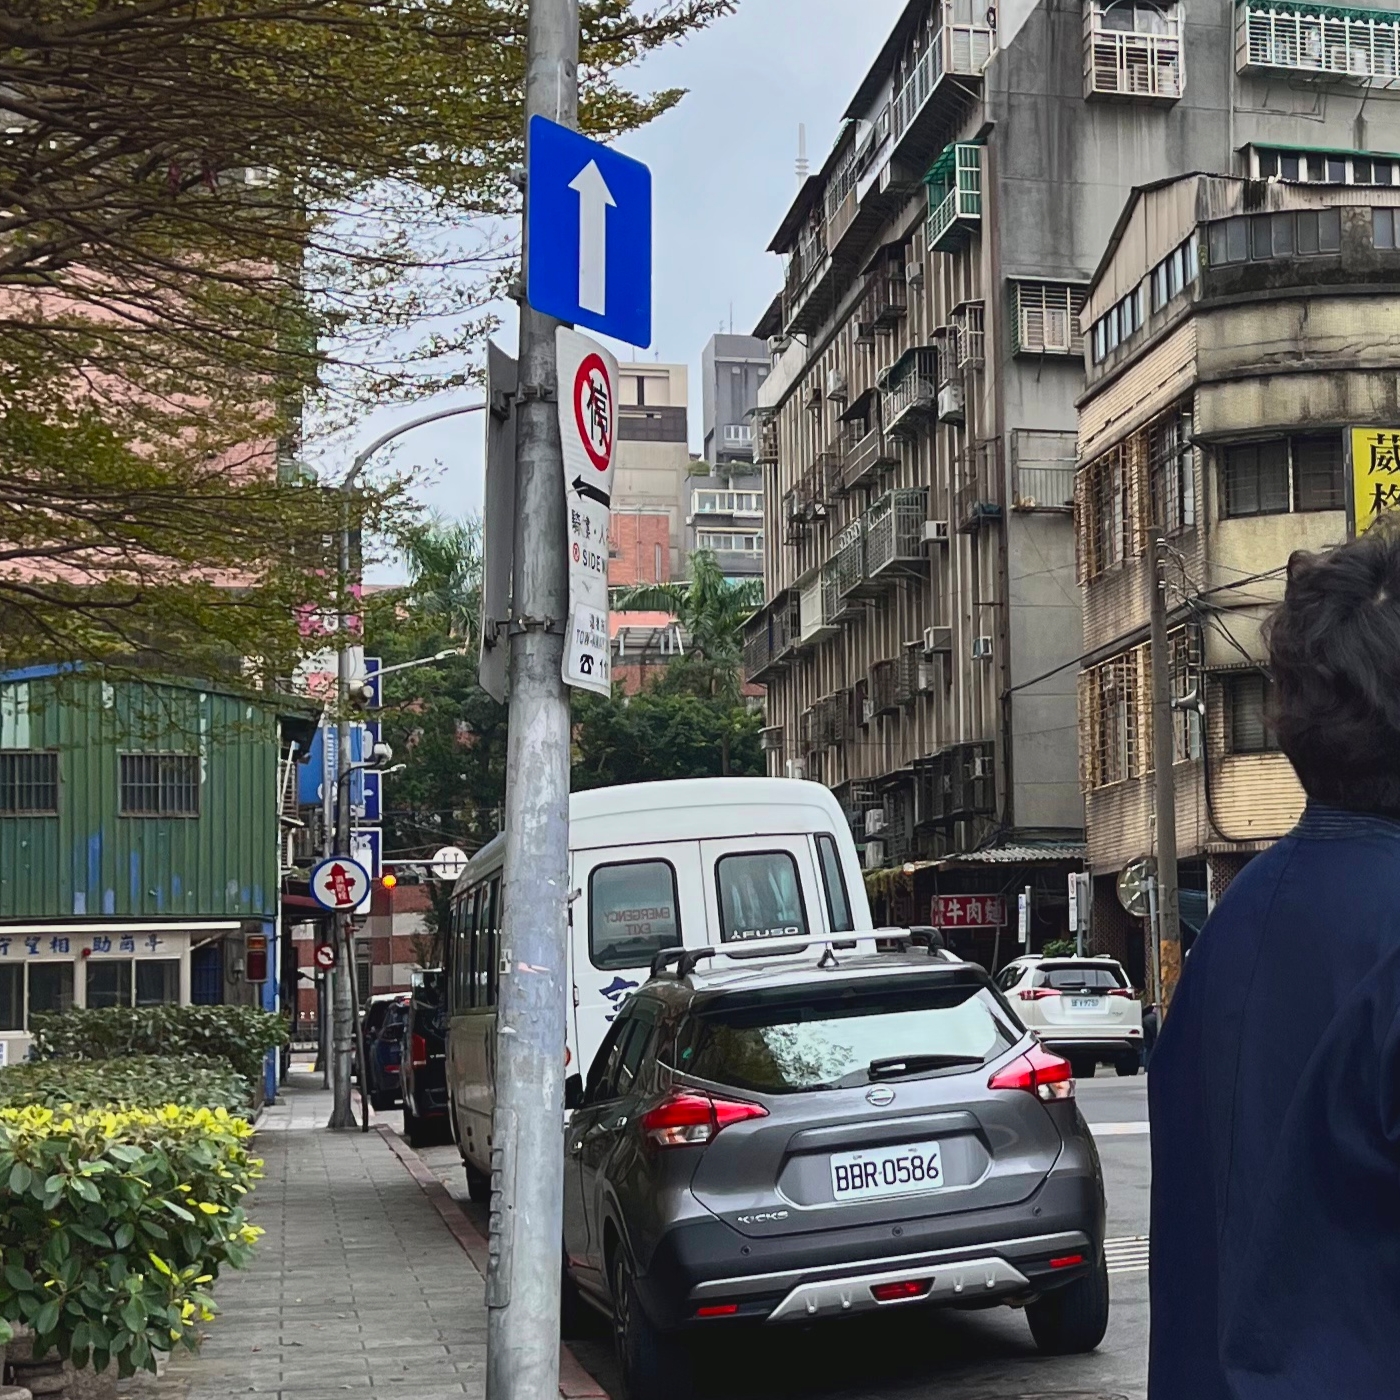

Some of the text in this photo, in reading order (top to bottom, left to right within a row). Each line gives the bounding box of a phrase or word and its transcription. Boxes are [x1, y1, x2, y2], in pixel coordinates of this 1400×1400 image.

[743, 926, 799, 939] FUSO
[835, 1153, 939, 1192] BBR-0586
[737, 1210, 789, 1225] KICKS
